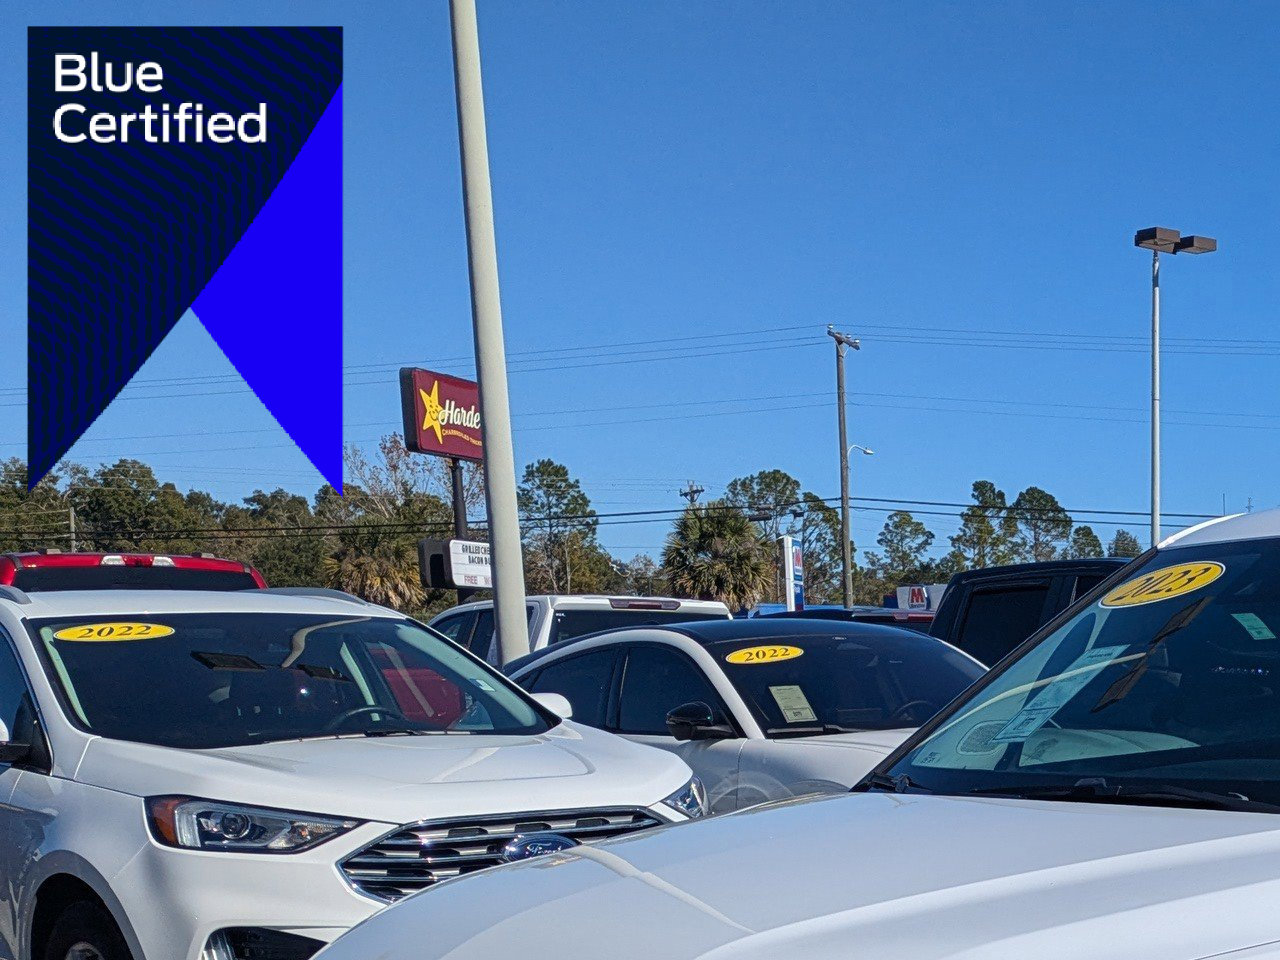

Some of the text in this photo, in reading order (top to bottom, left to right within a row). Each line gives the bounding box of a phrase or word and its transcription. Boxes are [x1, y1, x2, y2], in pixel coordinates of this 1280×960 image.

[438, 399, 481, 429] Harde
[462, 544, 491, 555] GRILLED CHE
[468, 555, 483, 565] BACON
[464, 575, 478, 585] FREE
[1109, 566, 1212, 602] 2023
[78, 625, 152, 639] 2022
[743, 648, 790, 662] 2022
